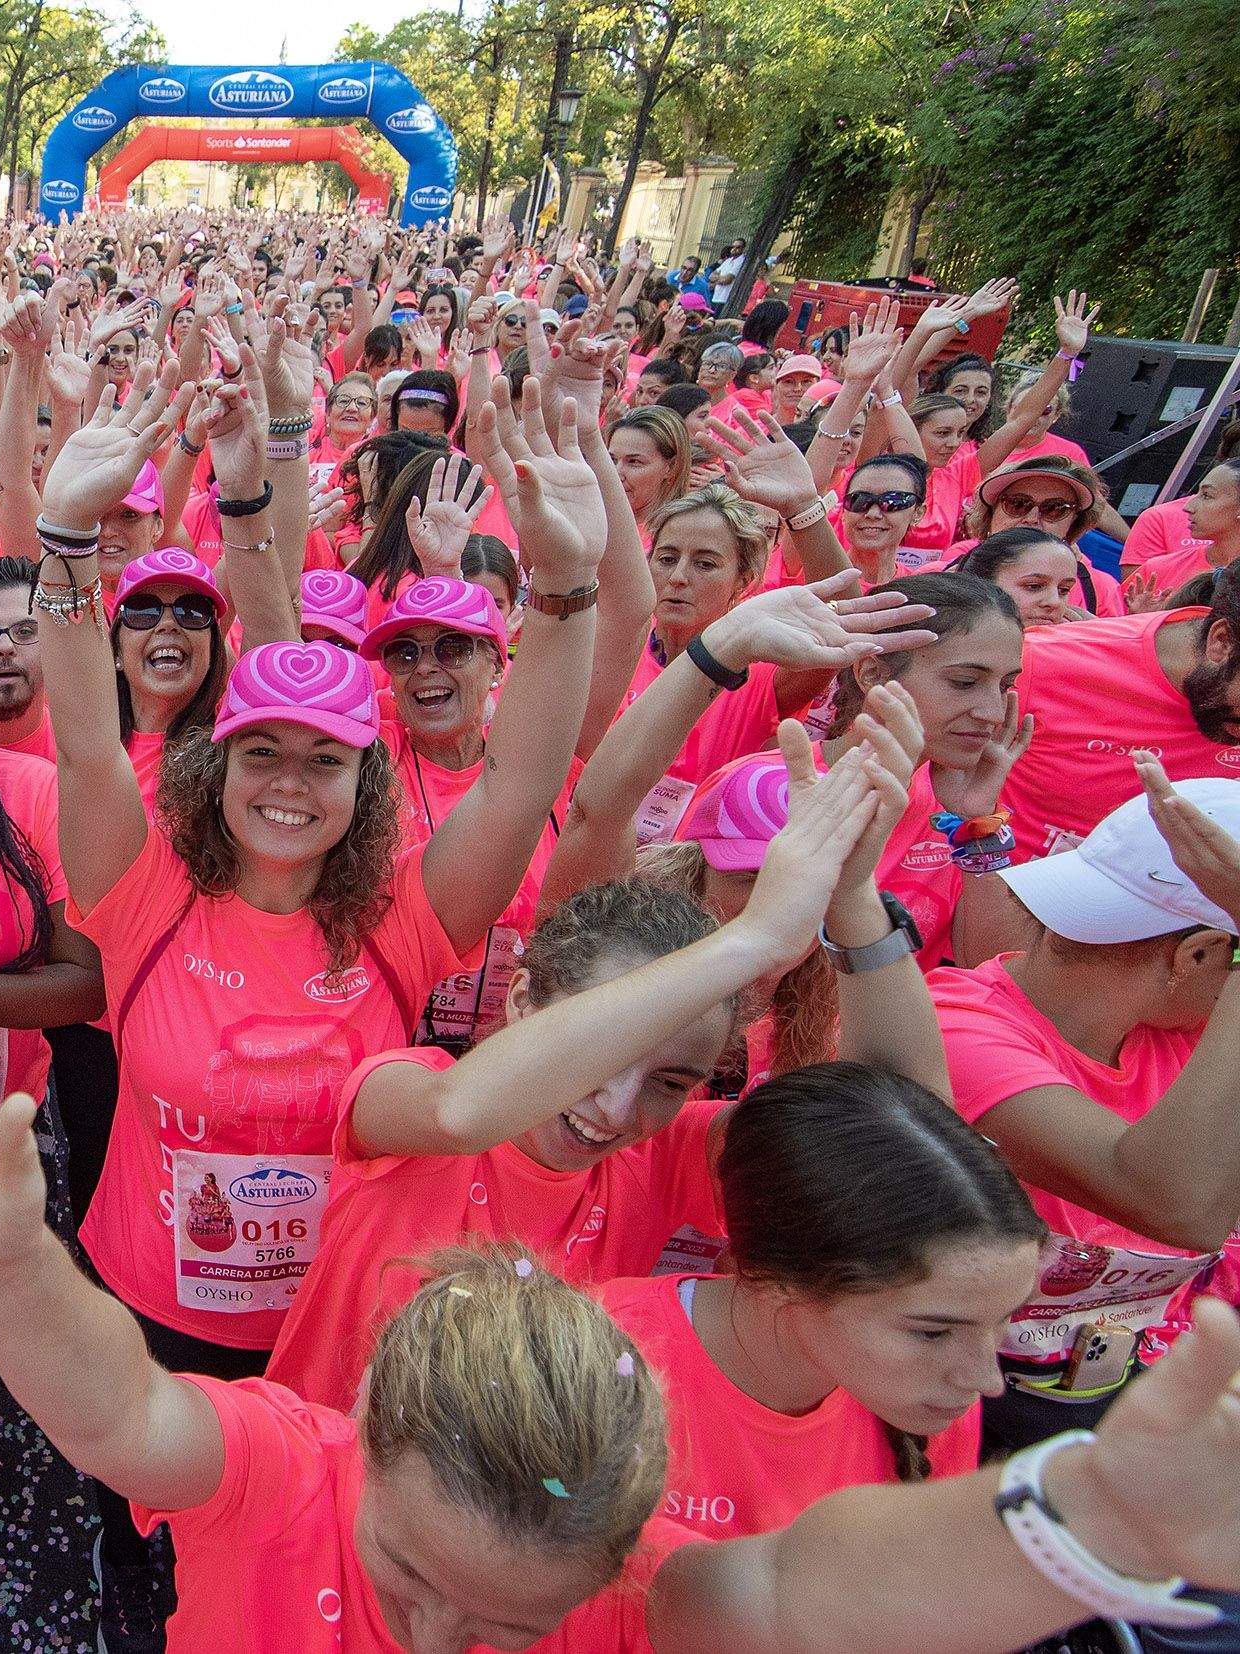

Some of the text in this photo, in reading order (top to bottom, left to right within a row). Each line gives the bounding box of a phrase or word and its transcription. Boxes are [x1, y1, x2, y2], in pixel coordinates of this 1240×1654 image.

[143, 86, 182, 97] ASTURIANA
[215, 84, 287, 102] ASTURIANA
[323, 87, 363, 98] ASTURIANA
[76, 115, 113, 126] ASTURIANA
[206, 136, 292, 149] Sports Santander
[43, 189, 77, 199] ASTURIANA
[653, 788, 679, 802] SUMA
[1044, 824, 1066, 848] T
[183, 953, 245, 989] OYSHO
[433, 1011, 473, 1021] LA MUJE
[152, 1093, 206, 1142] TU
[236, 1183, 311, 1199] ASTURIANA
[241, 1218, 308, 1242] 016
[255, 1245, 295, 1263] 5766
[199, 1265, 252, 1279] CARRERA
[255, 1269, 270, 1278] DE
[272, 1267, 286, 1277] LA
[656, 1259, 701, 1272] antander
[1100, 1269, 1175, 1286] 016
[195, 1286, 253, 1301] OYSHO
[1028, 1307, 1066, 1317] CARRE
[1018, 1323, 1070, 1344] OYSHO
[664, 1490, 735, 1523] SHO
